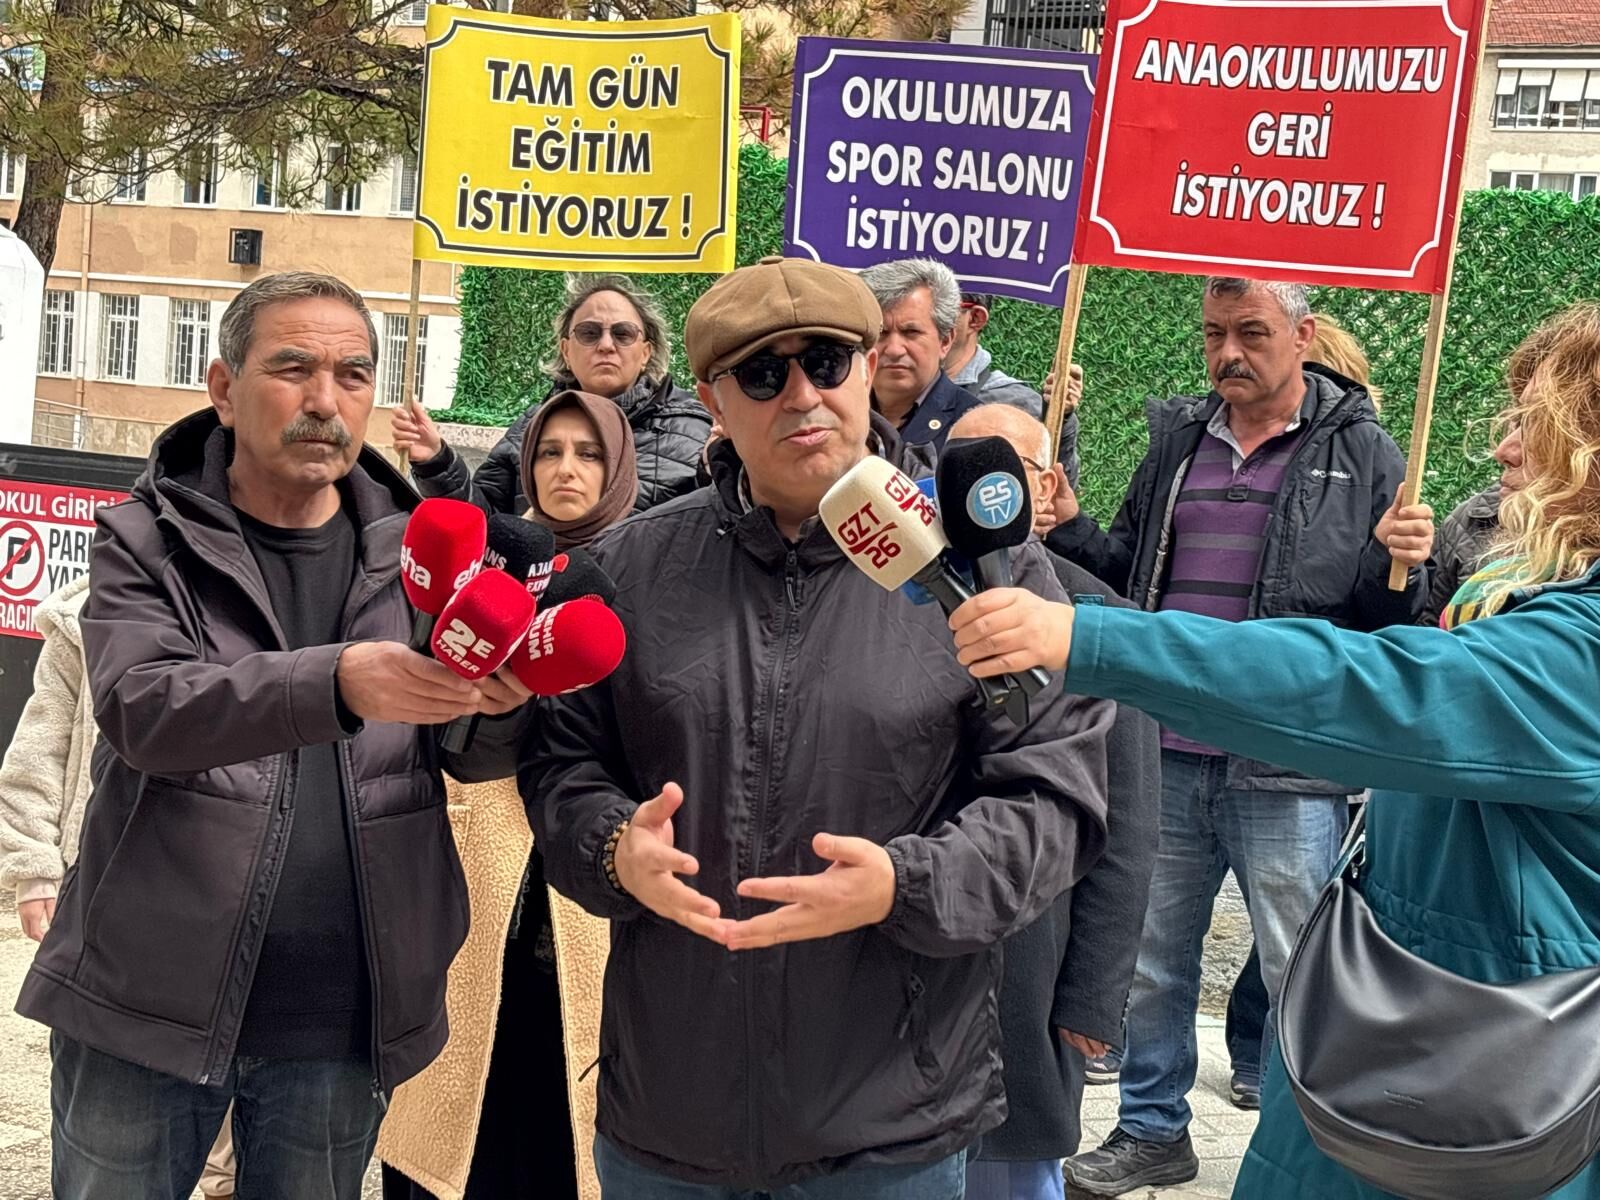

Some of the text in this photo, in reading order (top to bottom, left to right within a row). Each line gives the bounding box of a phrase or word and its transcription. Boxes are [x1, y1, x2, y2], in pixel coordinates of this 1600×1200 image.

[485, 54, 680, 109] TAM GÜN
[1133, 38, 1449, 93] ANAOKULUMUZU
[841, 75, 1072, 133] OKULUMUZA
[1246, 101, 1334, 159] GERİ
[510, 116, 652, 174] EĞİTİM
[825, 140, 1074, 201] SPOR SALONU
[456, 174, 671, 239] İSTİYORUZ
[1169, 160, 1367, 229] İSTİYORUZ
[846, 194, 1032, 261] İSTİYORUZ
[51, 492, 116, 522] GİRİ
[838, 502, 881, 545] GZT
[984, 501, 1013, 525] TV
[865, 534, 902, 569] 26
[436, 639, 480, 674] HABER
[441, 618, 496, 660] 2E
